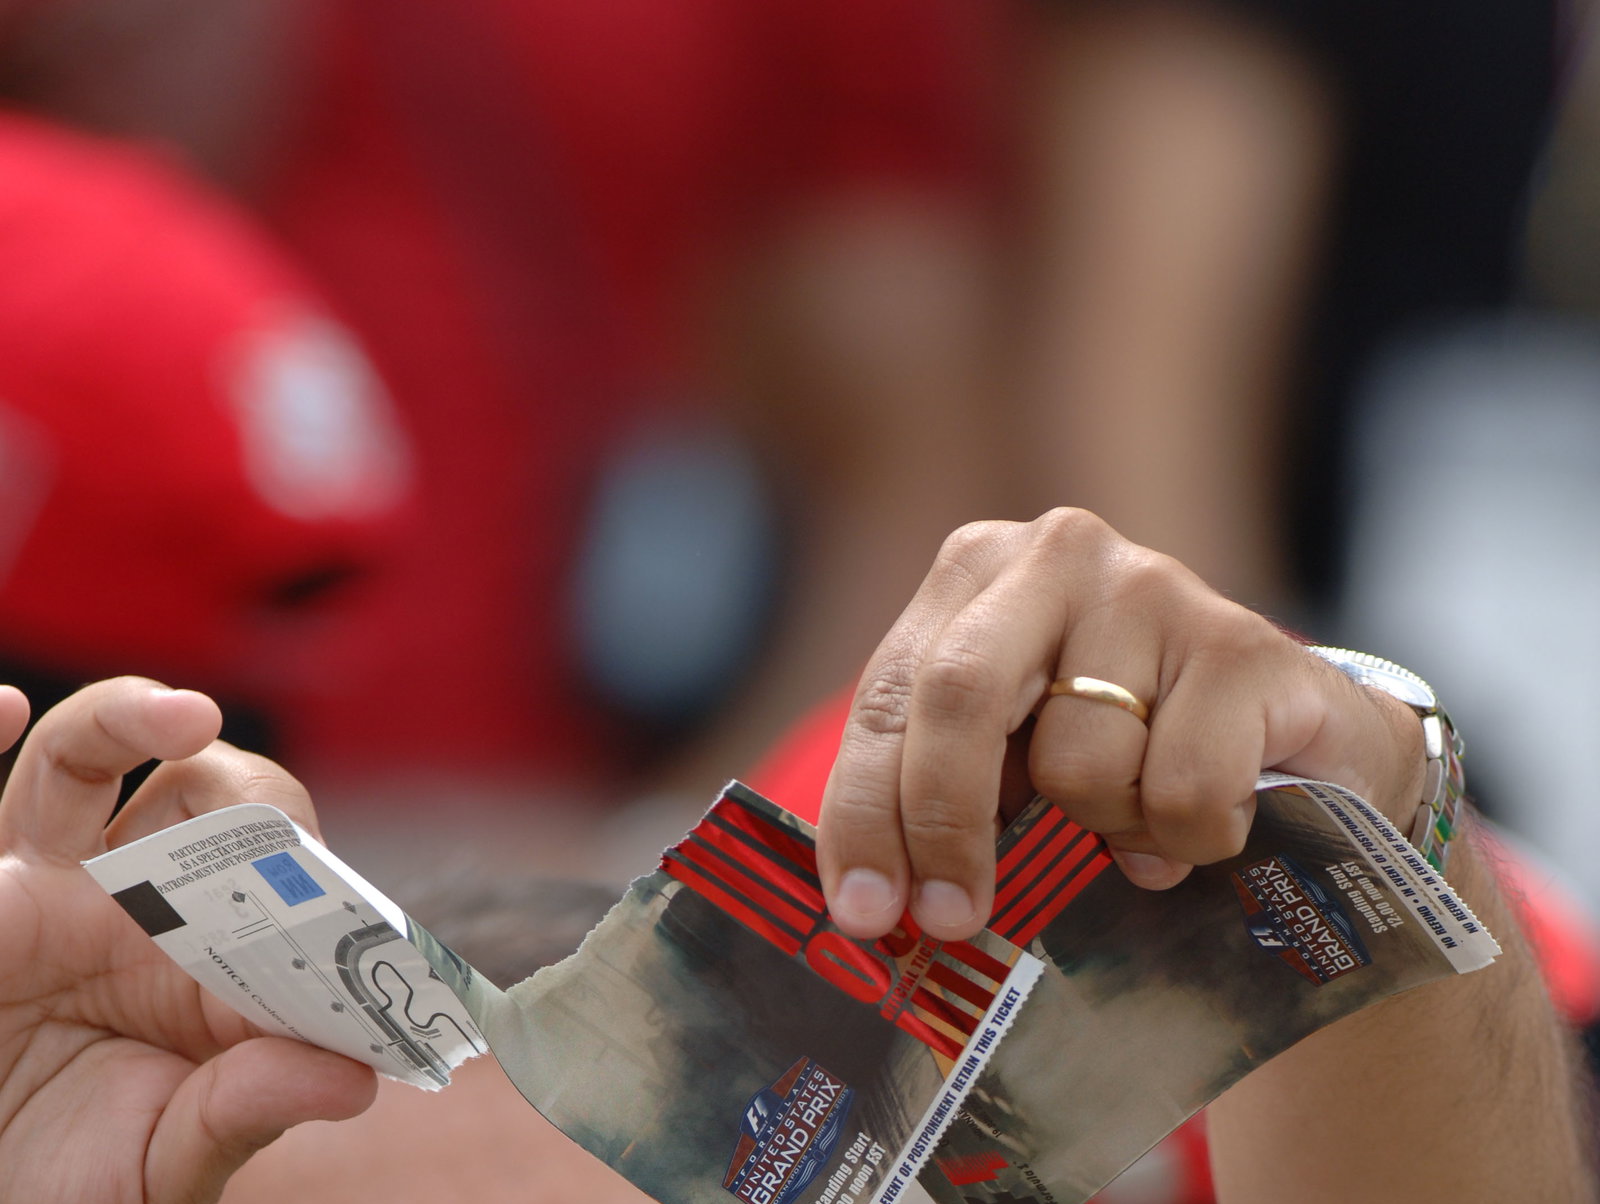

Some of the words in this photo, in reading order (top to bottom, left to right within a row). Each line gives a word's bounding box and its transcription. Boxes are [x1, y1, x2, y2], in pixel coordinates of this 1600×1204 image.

[168, 832, 232, 861] PARTICIPATION
[230, 828, 241, 838] IN
[239, 822, 261, 836] THIS
[1322, 800, 1378, 853] POSTPONEMENT
[179, 859, 192, 872] AS
[190, 856, 200, 868] A
[199, 841, 247, 865] SPECTATOR
[244, 838, 254, 848] IS
[252, 834, 264, 846] AT
[262, 830, 284, 842] YOUR
[1371, 853, 1387, 863] OF
[1392, 843, 1408, 853] OF
[1401, 854, 1428, 876] EVENT
[156, 872, 195, 894] PATRONS
[192, 865, 216, 881] MUST
[214, 857, 237, 872] HAVE
[236, 842, 278, 863] POSSESSION
[1260, 861, 1303, 905] PRIX
[1325, 865, 1352, 890] Start
[1341, 861, 1363, 877] EST
[1381, 865, 1407, 887] EVENT
[1422, 876, 1437, 886] IN
[1250, 867, 1294, 920] STATES
[1358, 877, 1383, 901] noon
[1401, 888, 1416, 897] IN
[1438, 893, 1468, 921] REFUND
[1347, 890, 1389, 934] Standing
[1375, 902, 1404, 928] 12:00
[1417, 906, 1447, 935] REFUND
[1462, 922, 1479, 934] NO
[1257, 894, 1318, 971] FORMULA
[1294, 924, 1338, 975] UNITED
[1296, 905, 1355, 971] GRAND
[1441, 936, 1458, 949] NO
[204, 946, 251, 993] NOTICE:
[880, 970, 919, 1020] OFFICIAL
[899, 1162, 914, 1177] OF
[907, 1090, 957, 1164] POSTPONEMENT
[951, 1055, 980, 1092] RETAIN
[974, 1027, 997, 1054] THIS
[991, 986, 1021, 1026] TICKET
[746, 1097, 769, 1134] F1
[802, 1077, 841, 1128] PRIX
[740, 1088, 800, 1177] FORMULA
[741, 1133, 786, 1197] UNITED
[785, 1070, 824, 1129] STATES
[844, 1132, 871, 1164] Start
[849, 1163, 874, 1195] noon
[866, 1142, 886, 1166] EST
